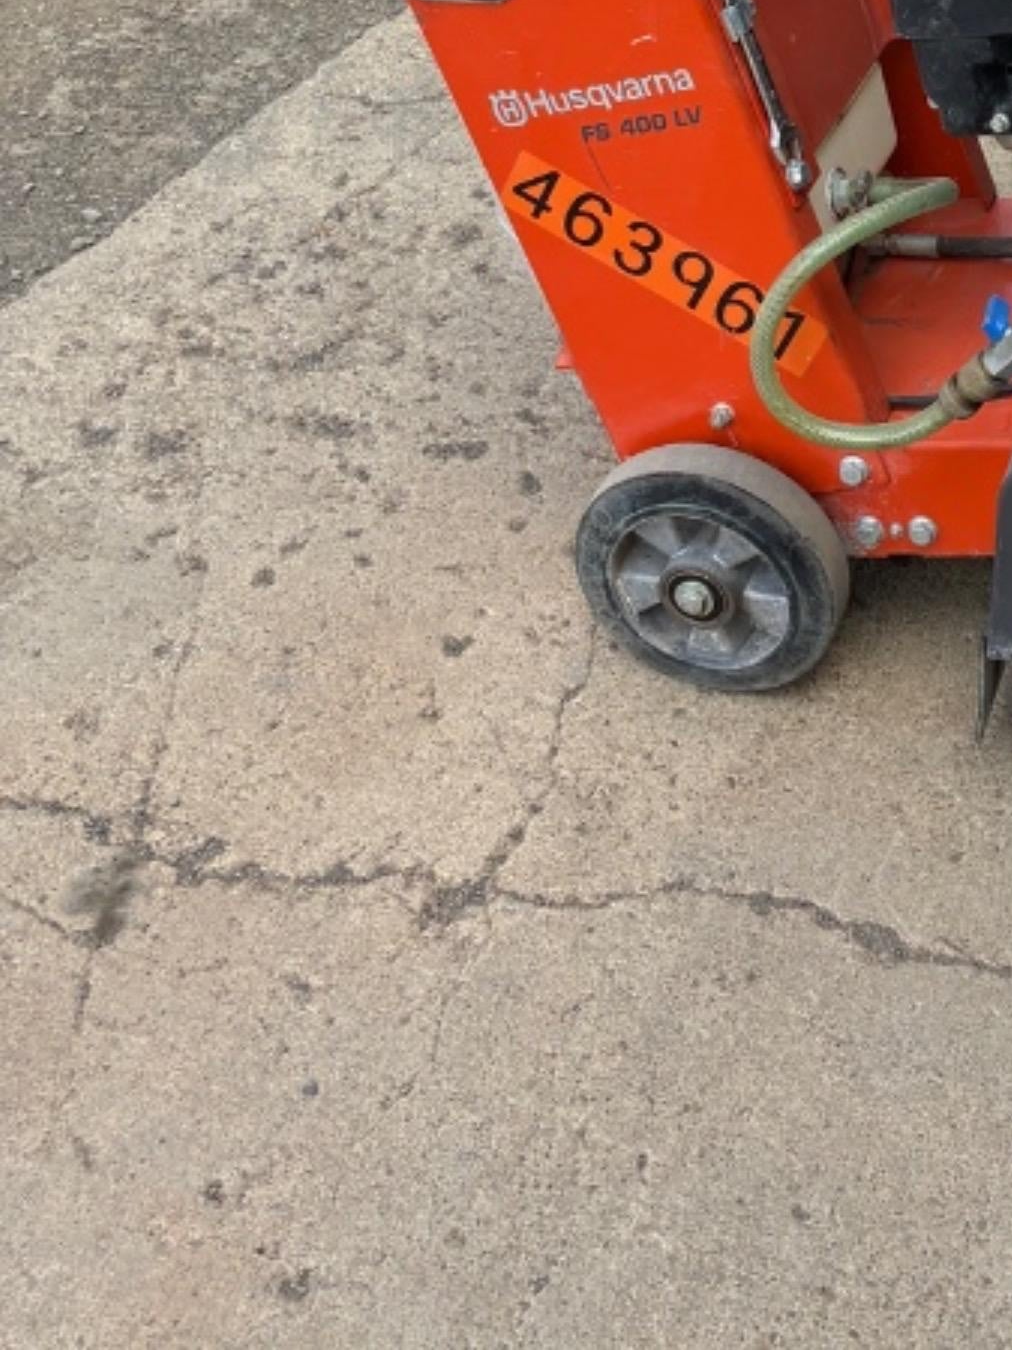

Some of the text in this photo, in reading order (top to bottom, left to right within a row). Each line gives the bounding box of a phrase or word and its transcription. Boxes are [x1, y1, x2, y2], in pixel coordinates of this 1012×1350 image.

[523, 67, 695, 118] Husqvarna
[580, 105, 702, 143] FS 400 LV
[511, 170, 805, 361] 463961
